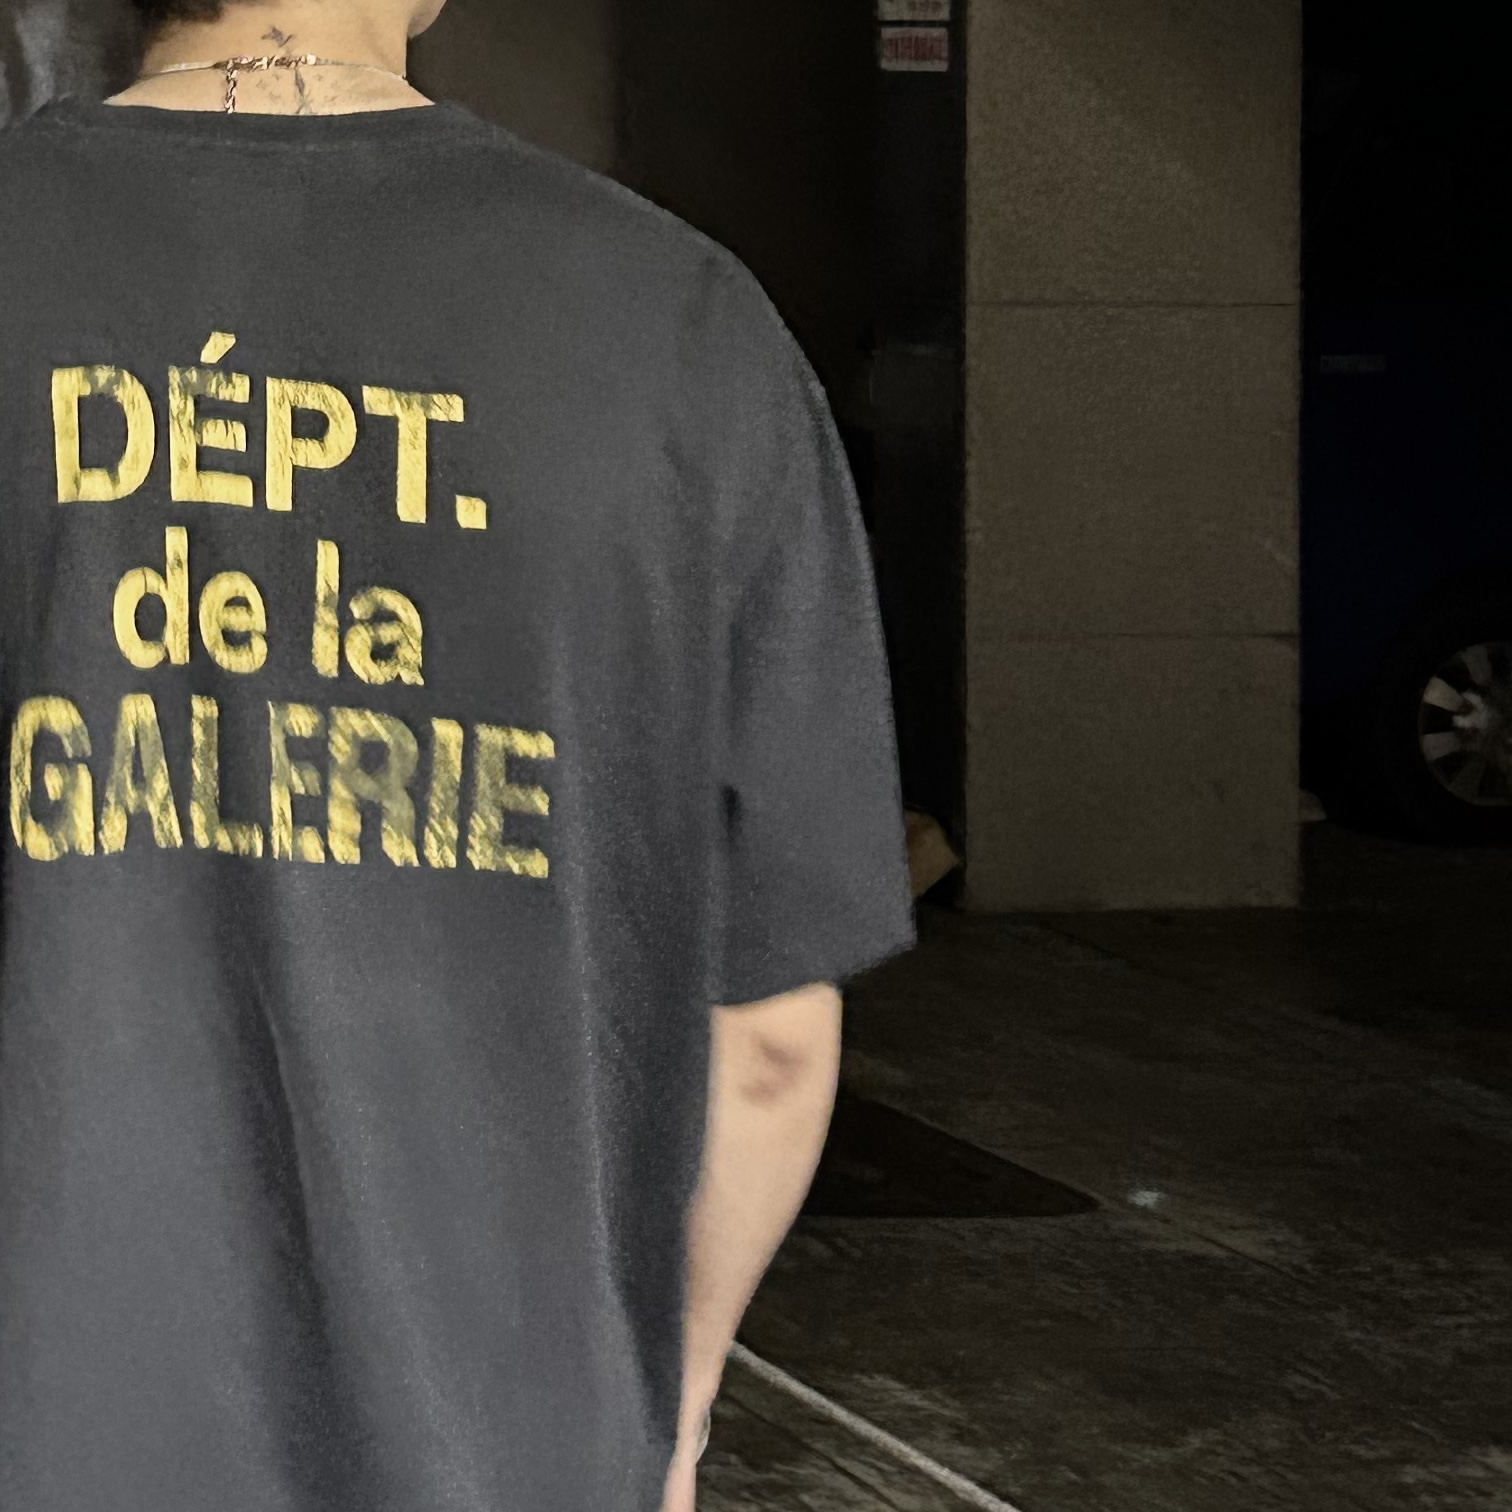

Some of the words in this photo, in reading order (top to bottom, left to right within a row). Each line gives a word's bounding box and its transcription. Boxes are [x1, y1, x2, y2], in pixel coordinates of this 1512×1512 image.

[51, 331, 487, 530] DÉPT.
[113, 526, 268, 673] de
[312, 539, 424, 686] la
[10, 693, 555, 879] GALERIE
